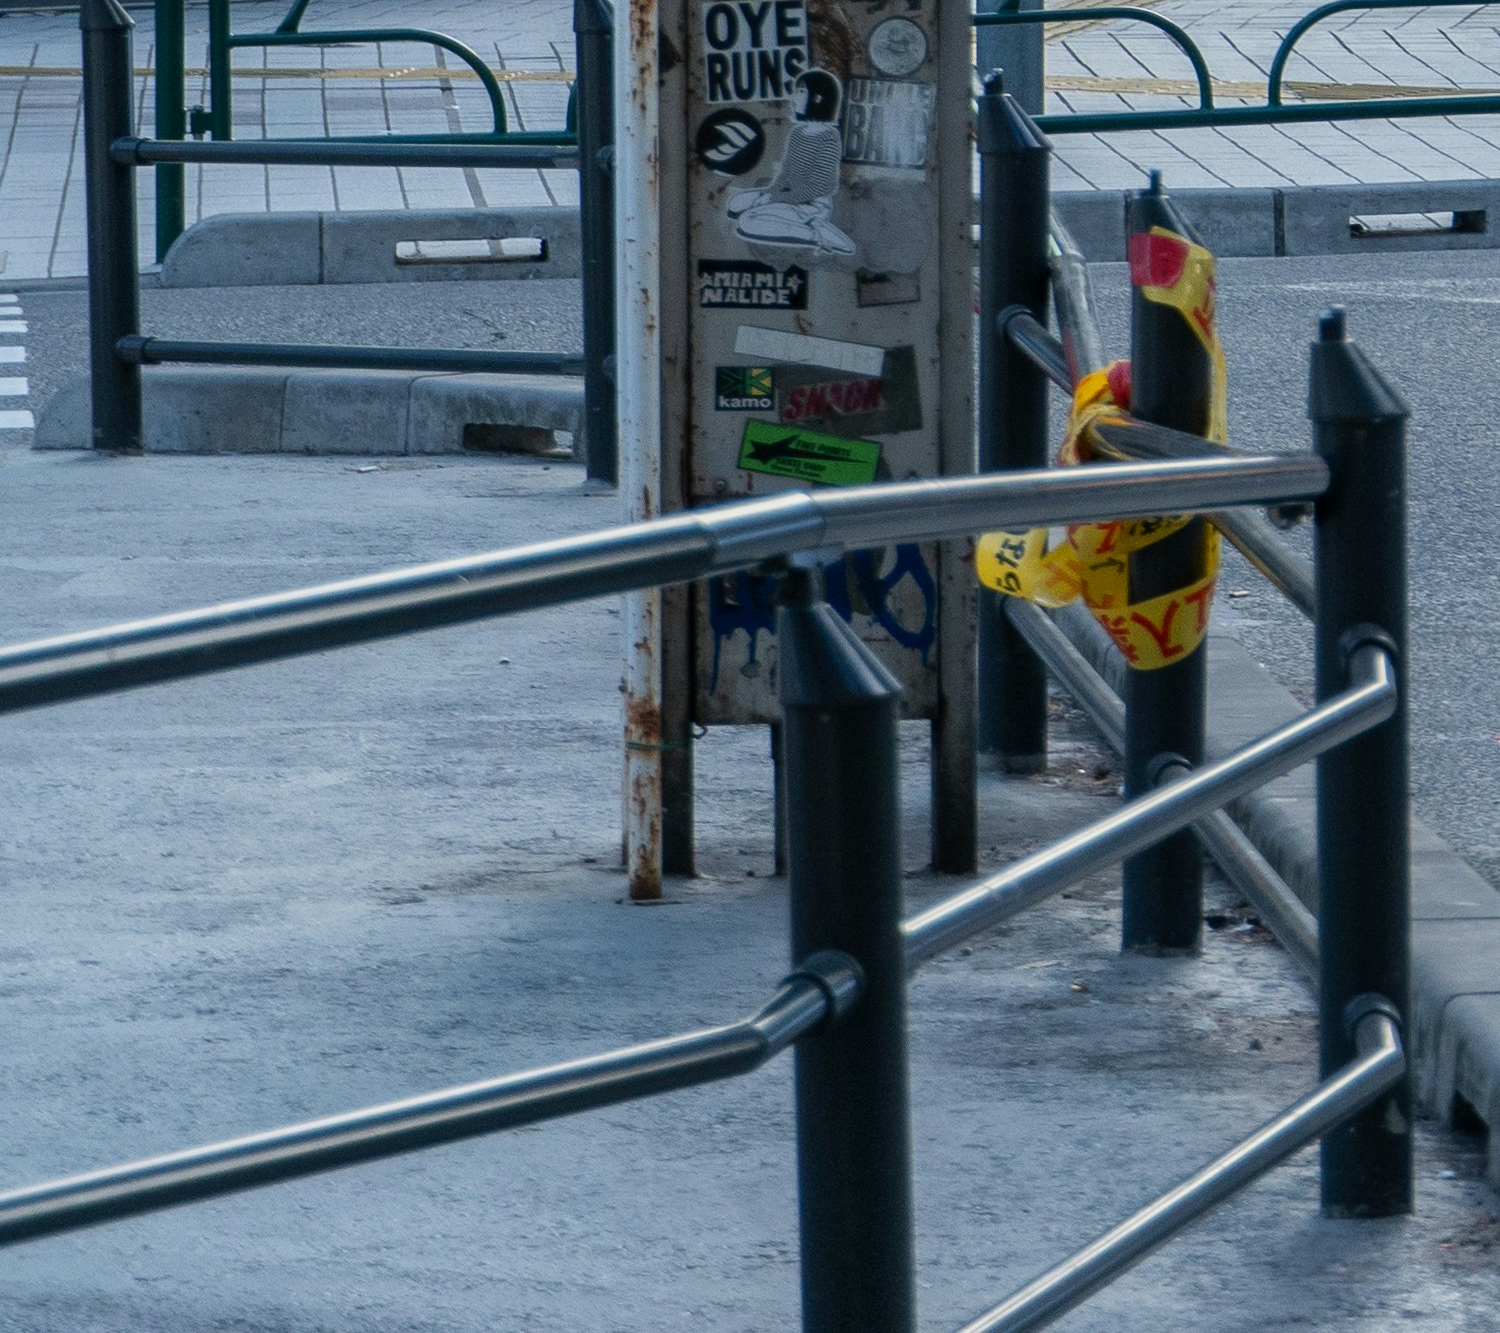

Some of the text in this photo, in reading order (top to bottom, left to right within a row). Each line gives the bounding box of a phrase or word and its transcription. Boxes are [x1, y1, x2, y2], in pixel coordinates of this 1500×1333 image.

[704, 0, 806, 51] OYE
[706, 47, 808, 103] RUNS
[718, 394, 772, 409] kamo
